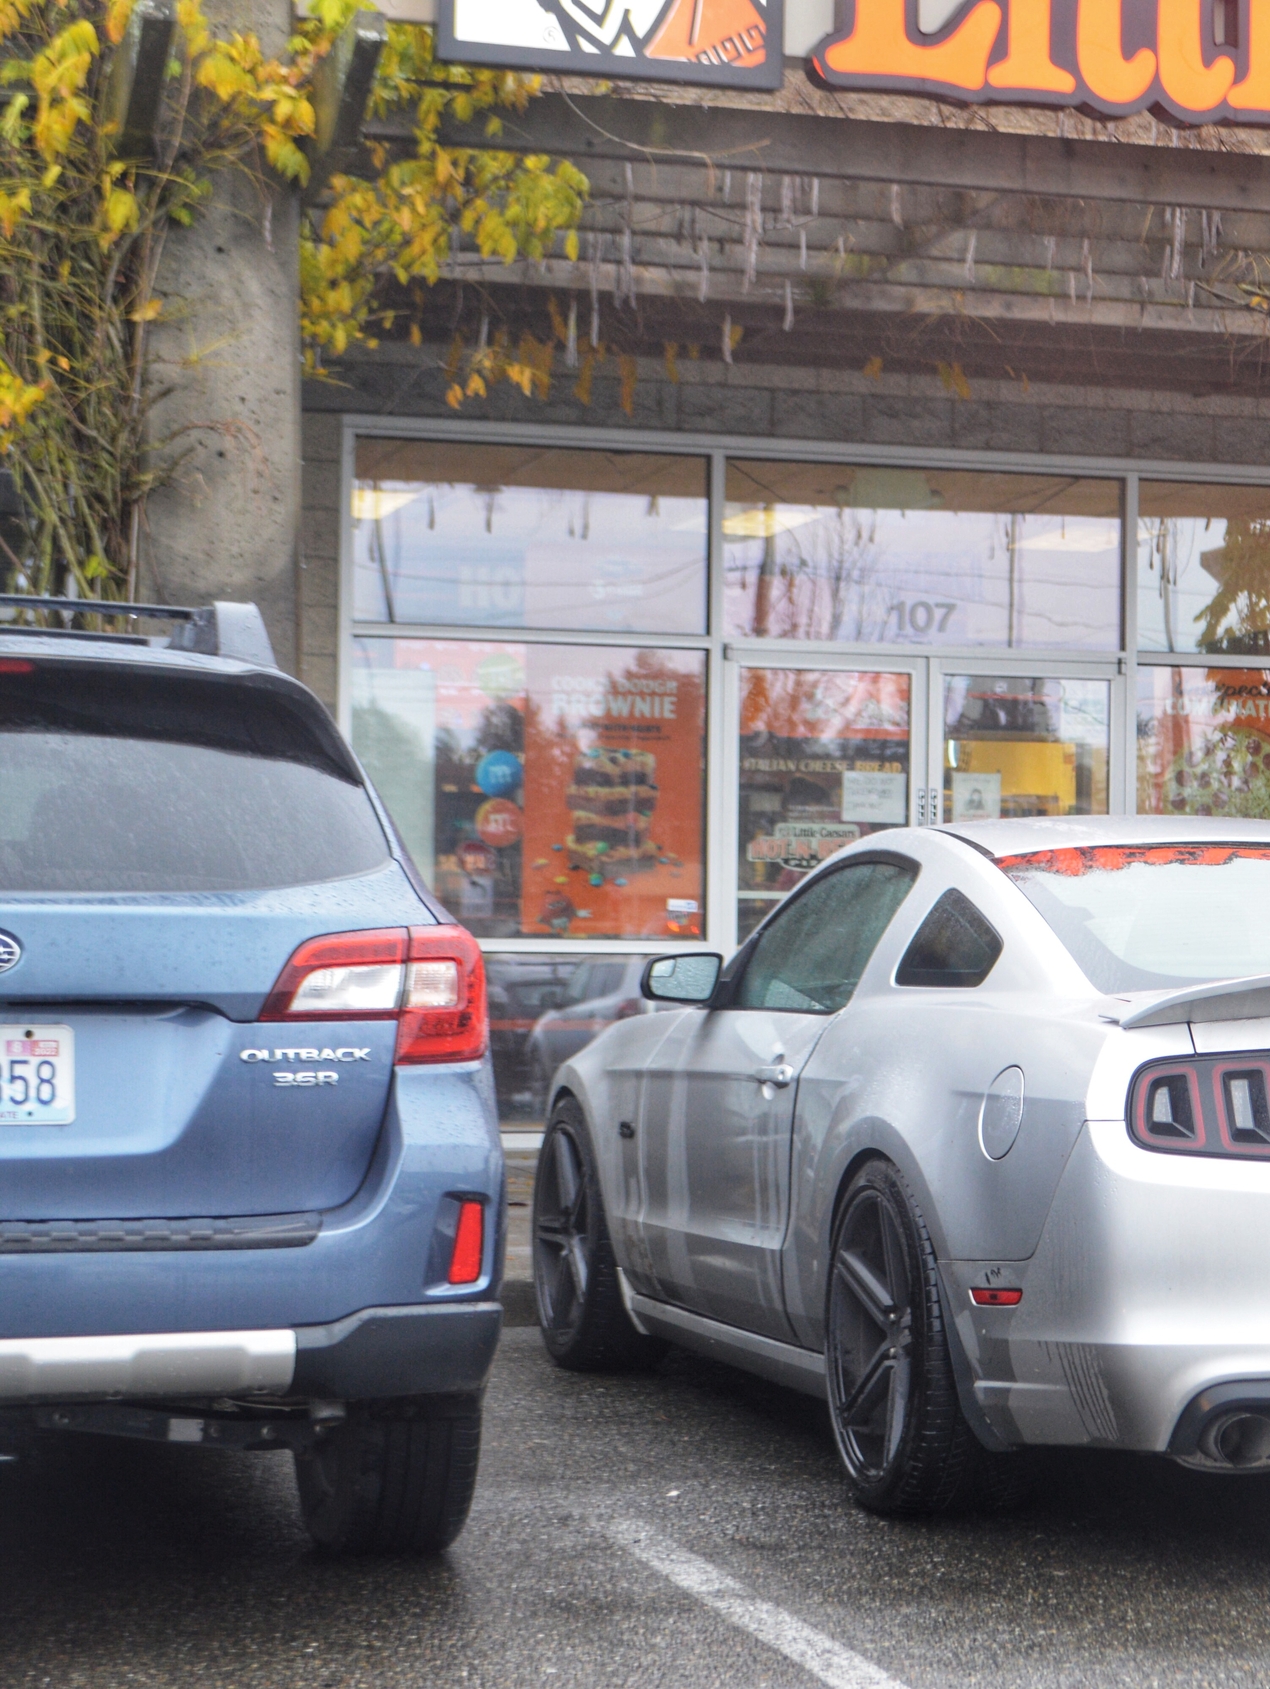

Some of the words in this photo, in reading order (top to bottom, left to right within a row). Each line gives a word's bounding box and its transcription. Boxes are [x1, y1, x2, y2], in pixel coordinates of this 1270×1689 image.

[890, 601, 958, 632] 107
[618, 678, 678, 694] DOUGH
[551, 693, 678, 719] BROWNIE
[741, 758, 796, 772] ITALIAN
[801, 760, 850, 773] CHEESE
[854, 761, 903, 774] BREAD
[750, 838, 854, 859] HOT-N-RE
[240, 1047, 371, 1063] OUTBACK
[0, 1060, 56, 1106] 58
